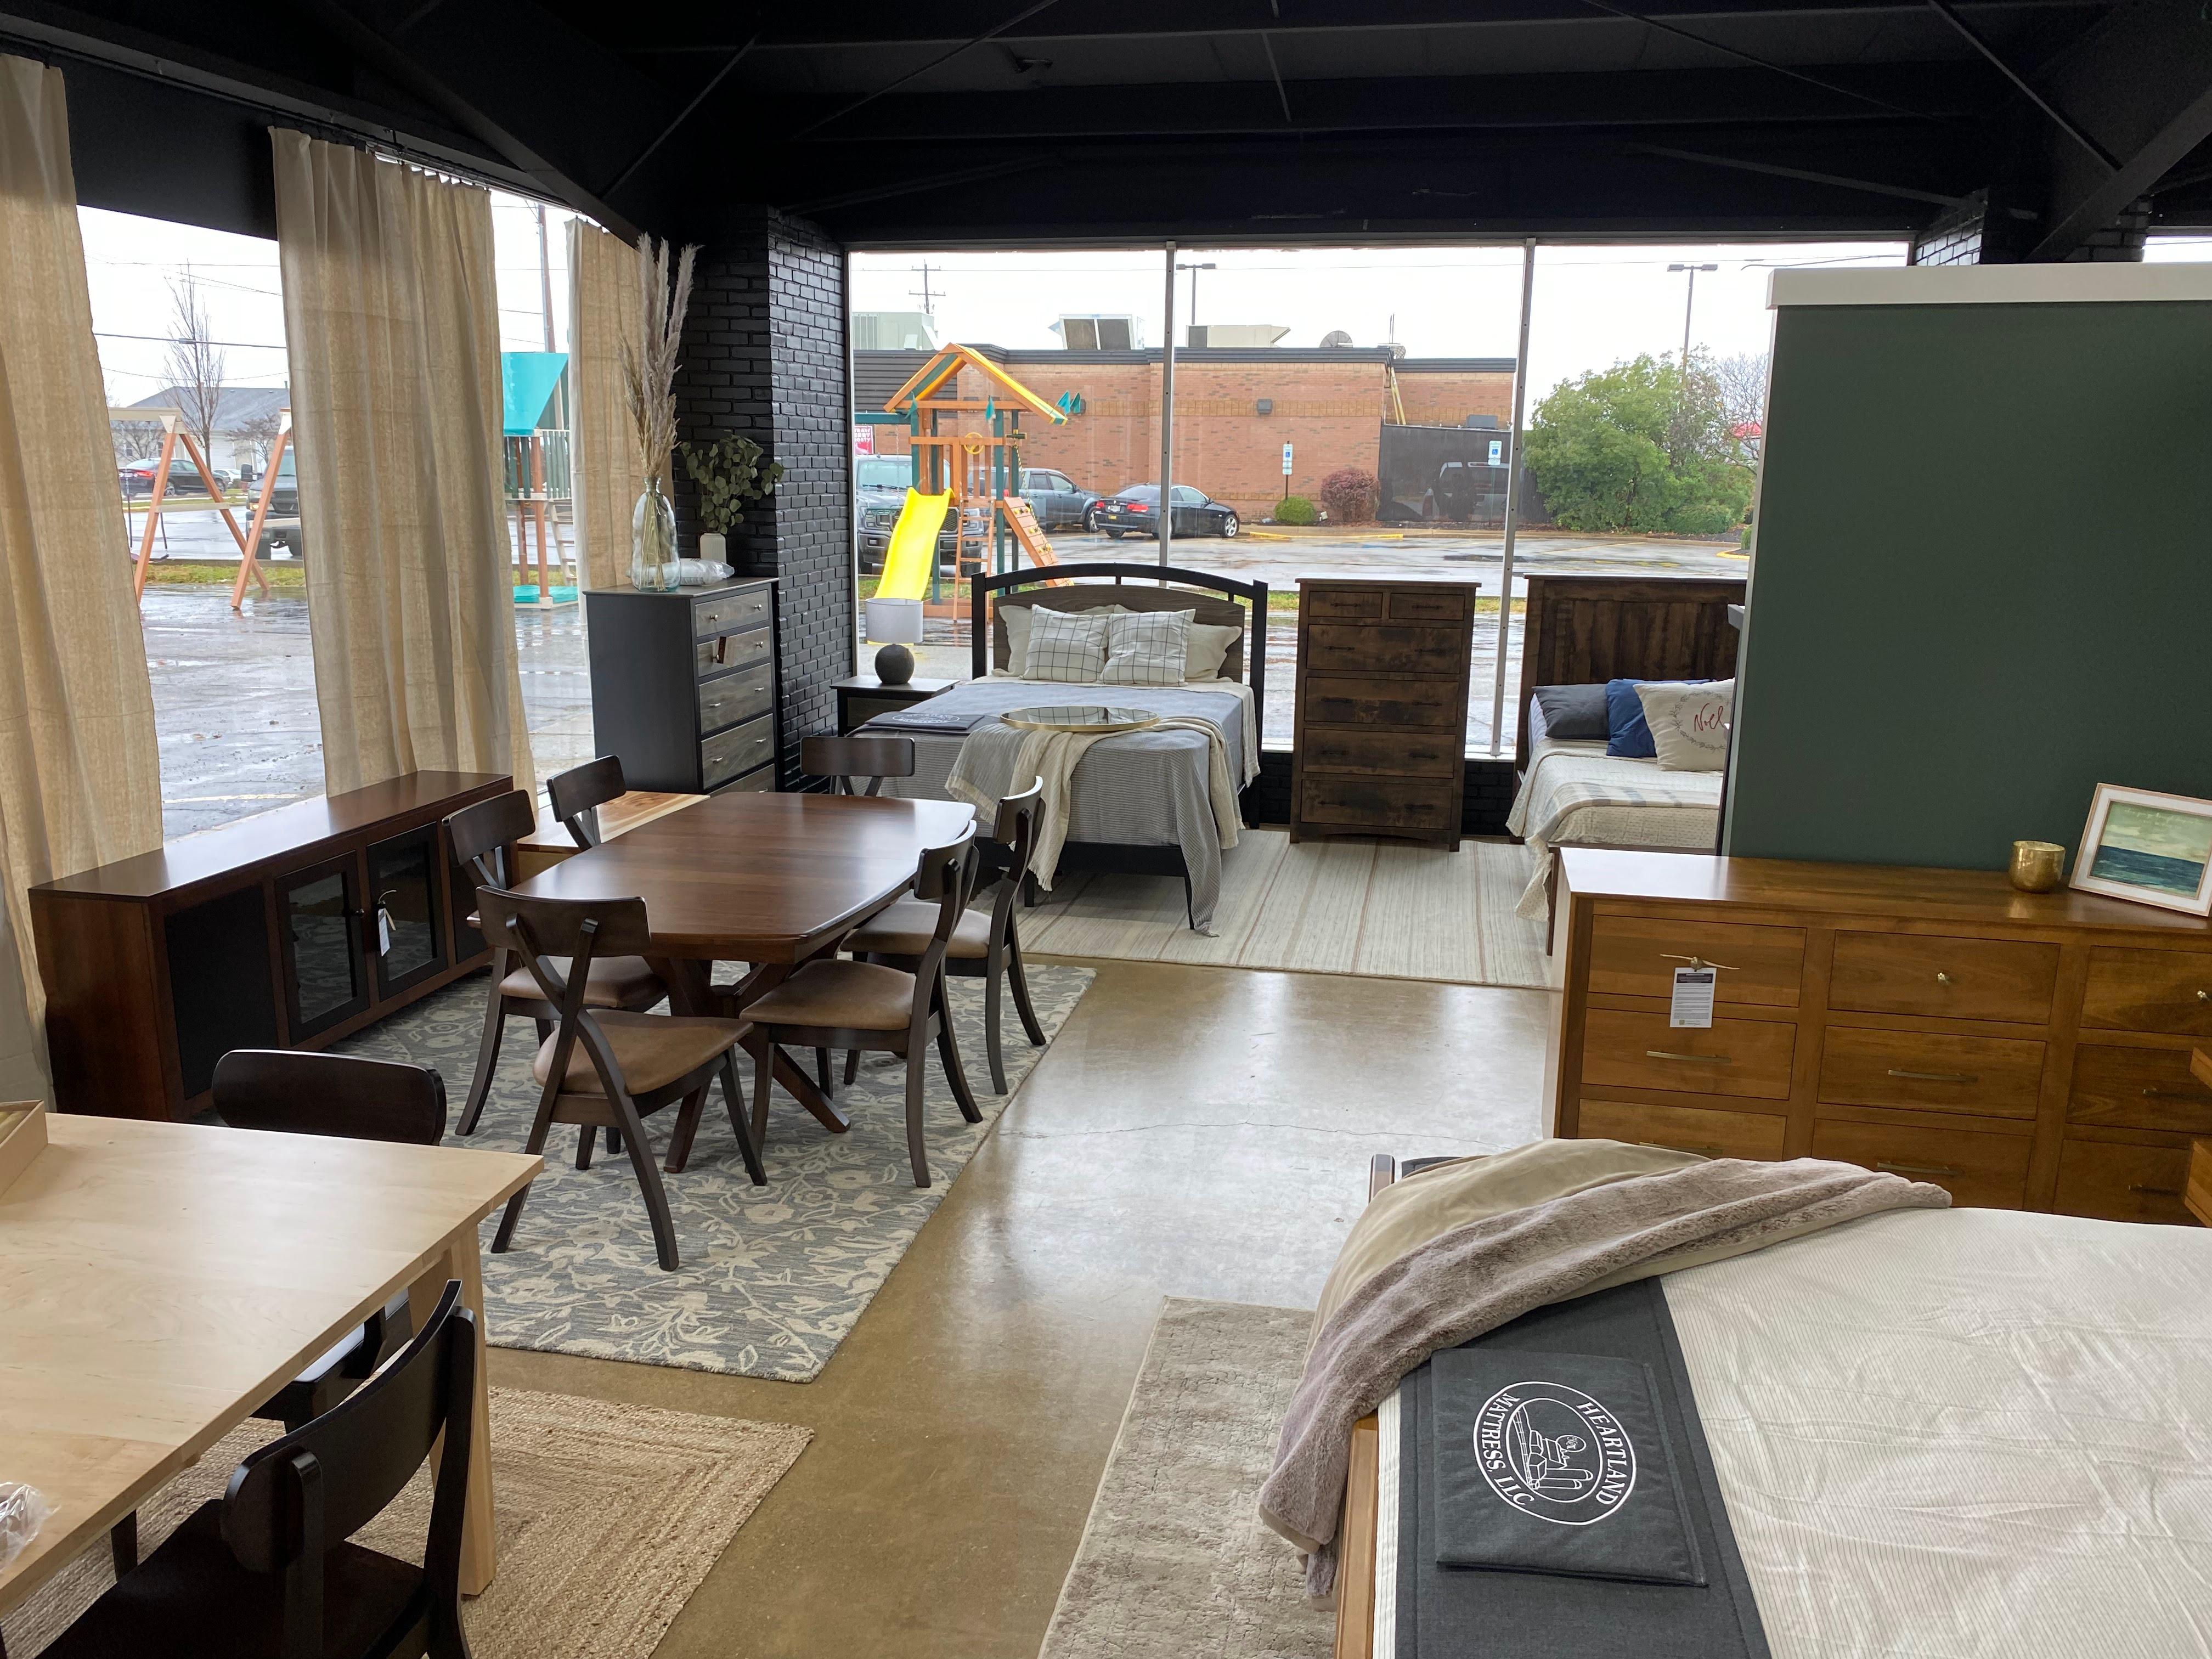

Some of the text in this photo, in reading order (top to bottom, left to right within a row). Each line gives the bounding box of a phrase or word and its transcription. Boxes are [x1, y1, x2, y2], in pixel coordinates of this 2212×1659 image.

[1694, 703, 1725, 732] Noel
[1482, 1393, 1534, 1505] MATTRESS, LLC
[1576, 1402, 1628, 1504] HEARTLAND
